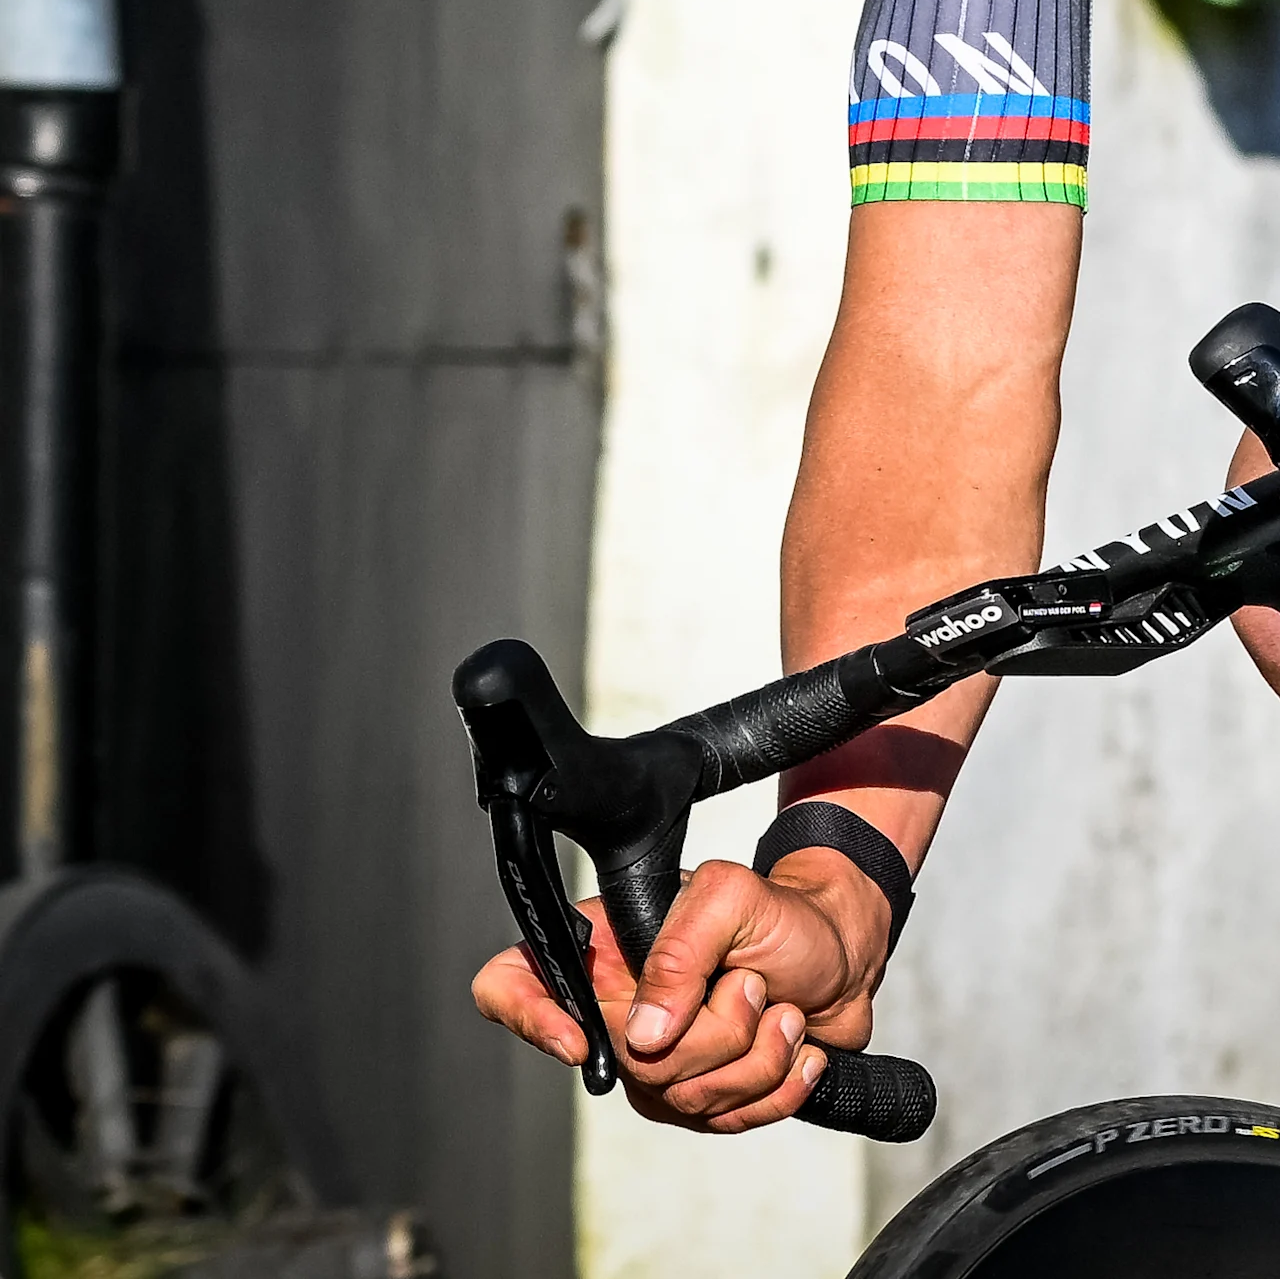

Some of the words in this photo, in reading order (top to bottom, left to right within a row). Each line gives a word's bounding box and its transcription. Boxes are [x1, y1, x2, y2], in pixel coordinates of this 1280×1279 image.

[914, 603, 1005, 650] wahoo
[1096, 1129, 1119, 1154] P
[1125, 1115, 1230, 1144] ZERO
